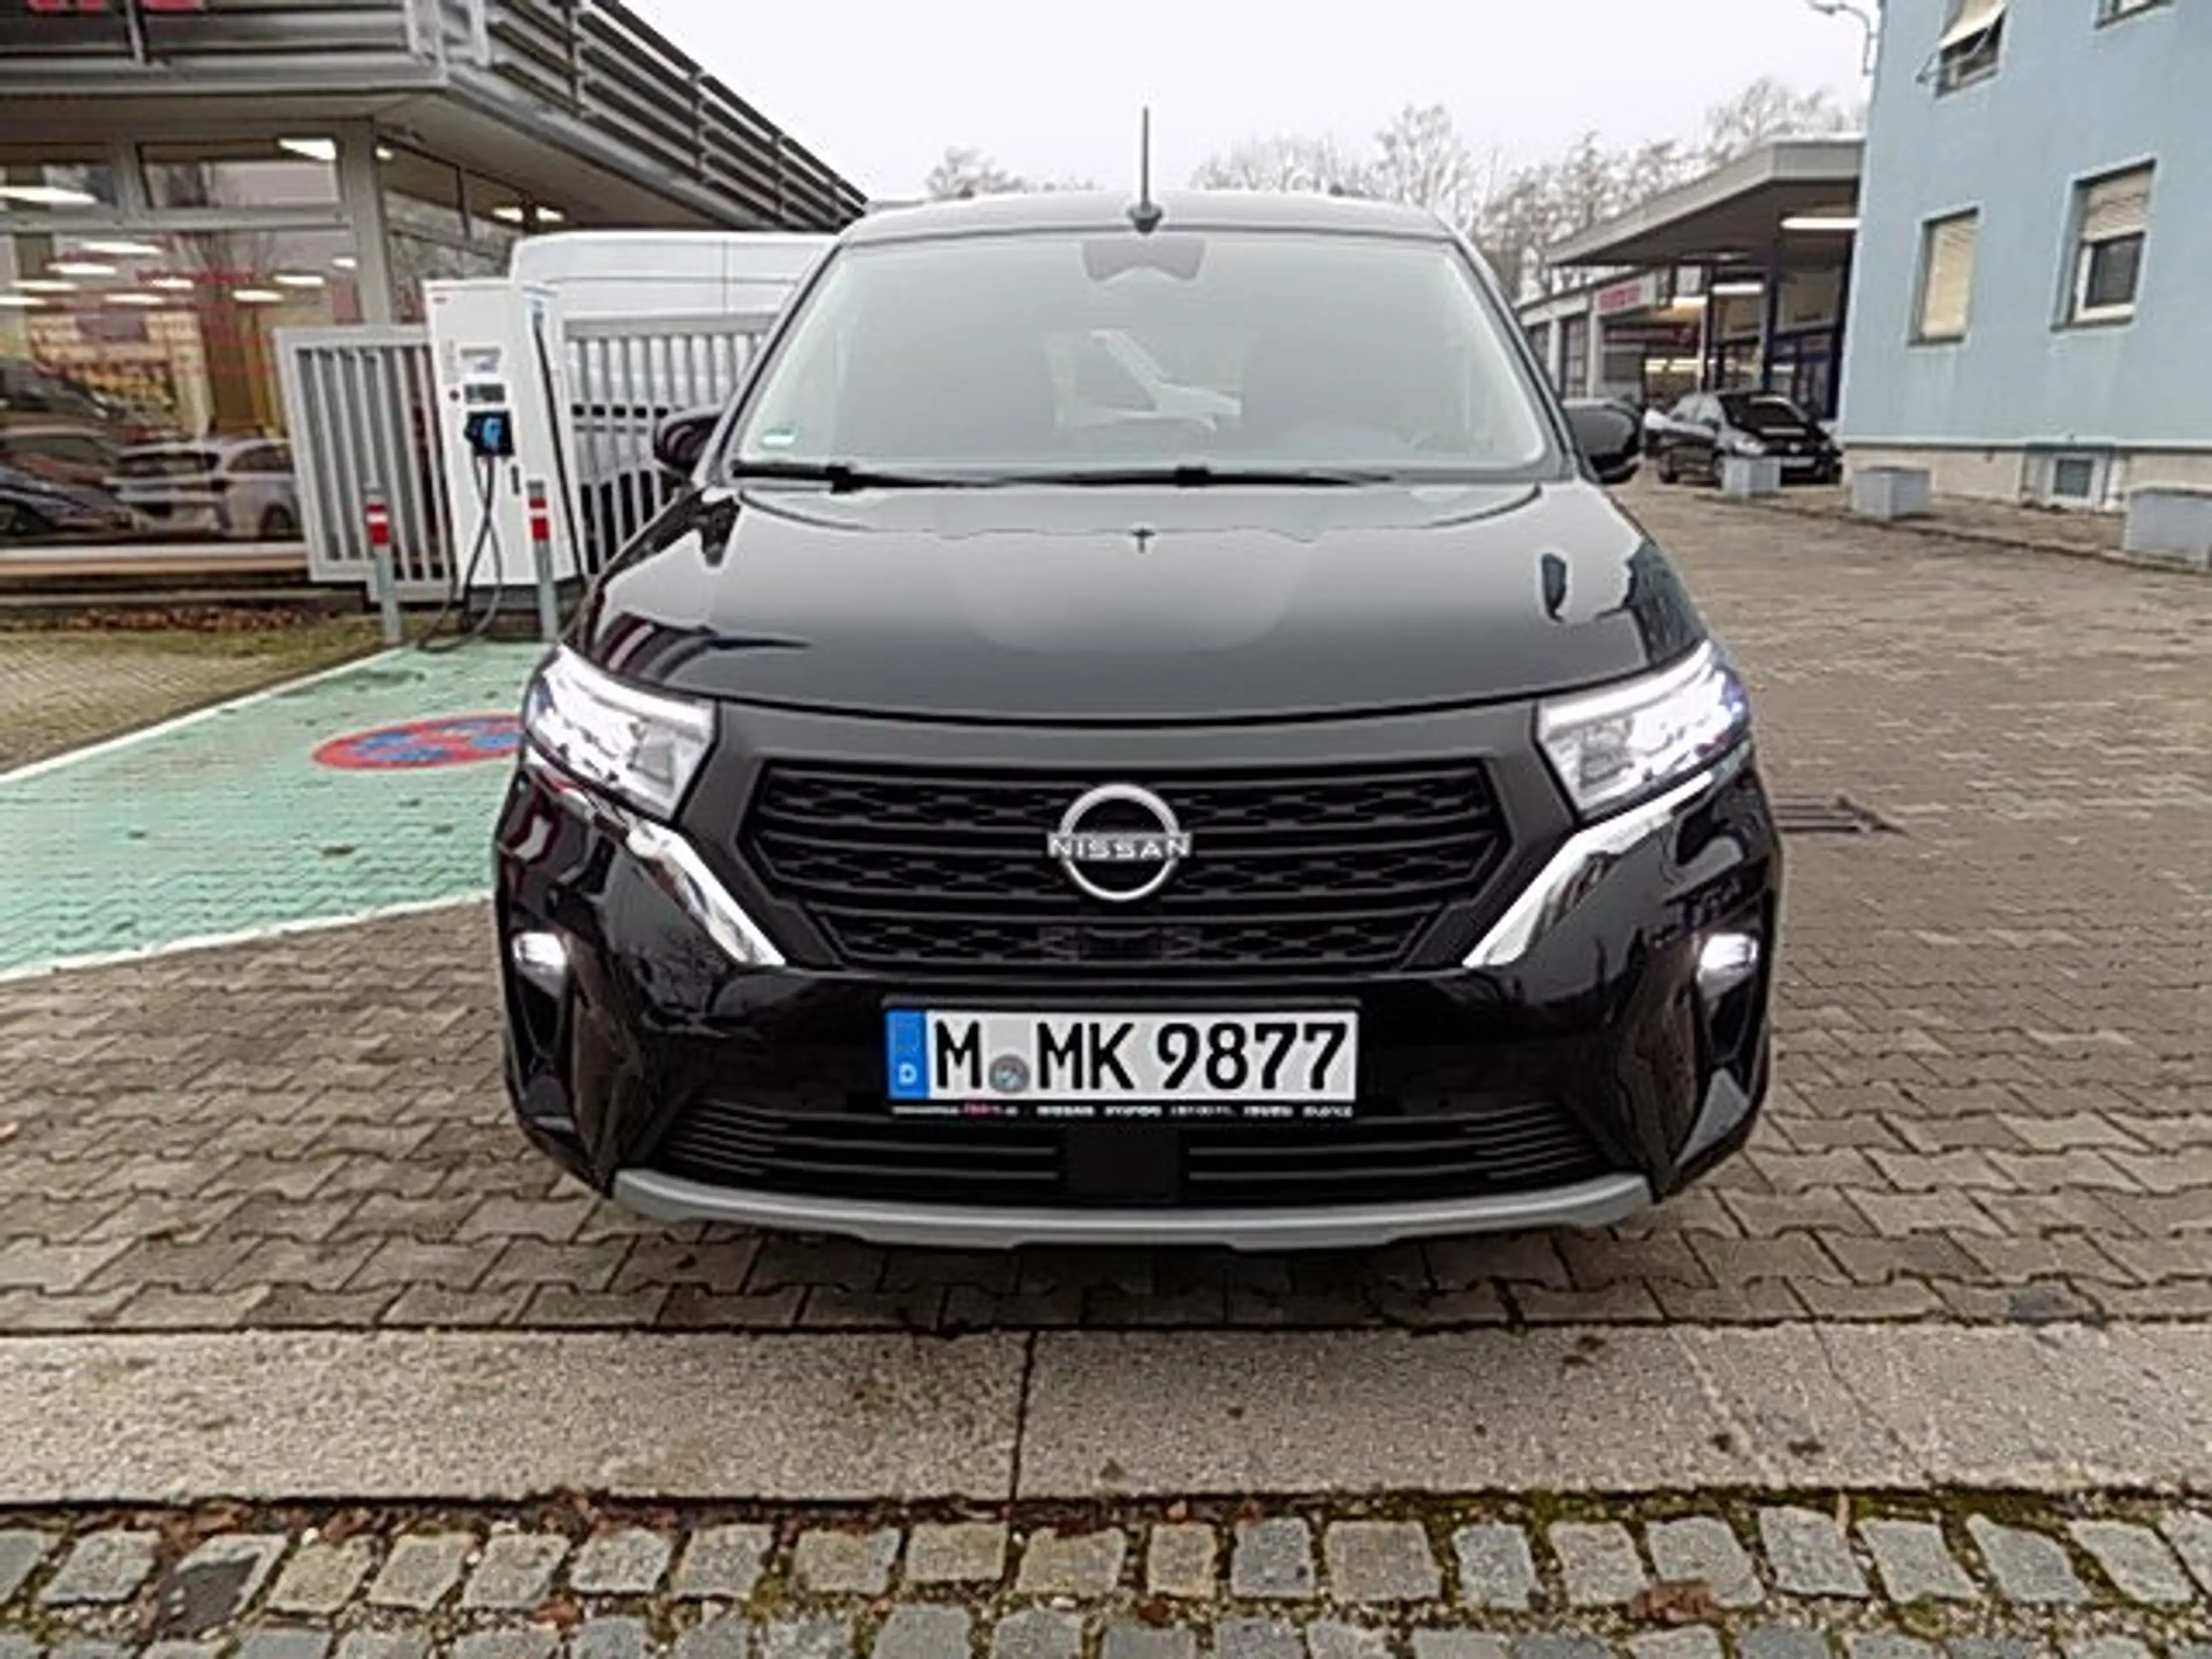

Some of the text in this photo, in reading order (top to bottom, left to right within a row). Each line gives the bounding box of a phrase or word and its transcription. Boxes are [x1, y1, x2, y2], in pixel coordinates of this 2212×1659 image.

[1048, 835, 1191, 859] NISSAN
[935, 1019, 1347, 1089] M MK 9877
[899, 1062, 918, 1086] D
